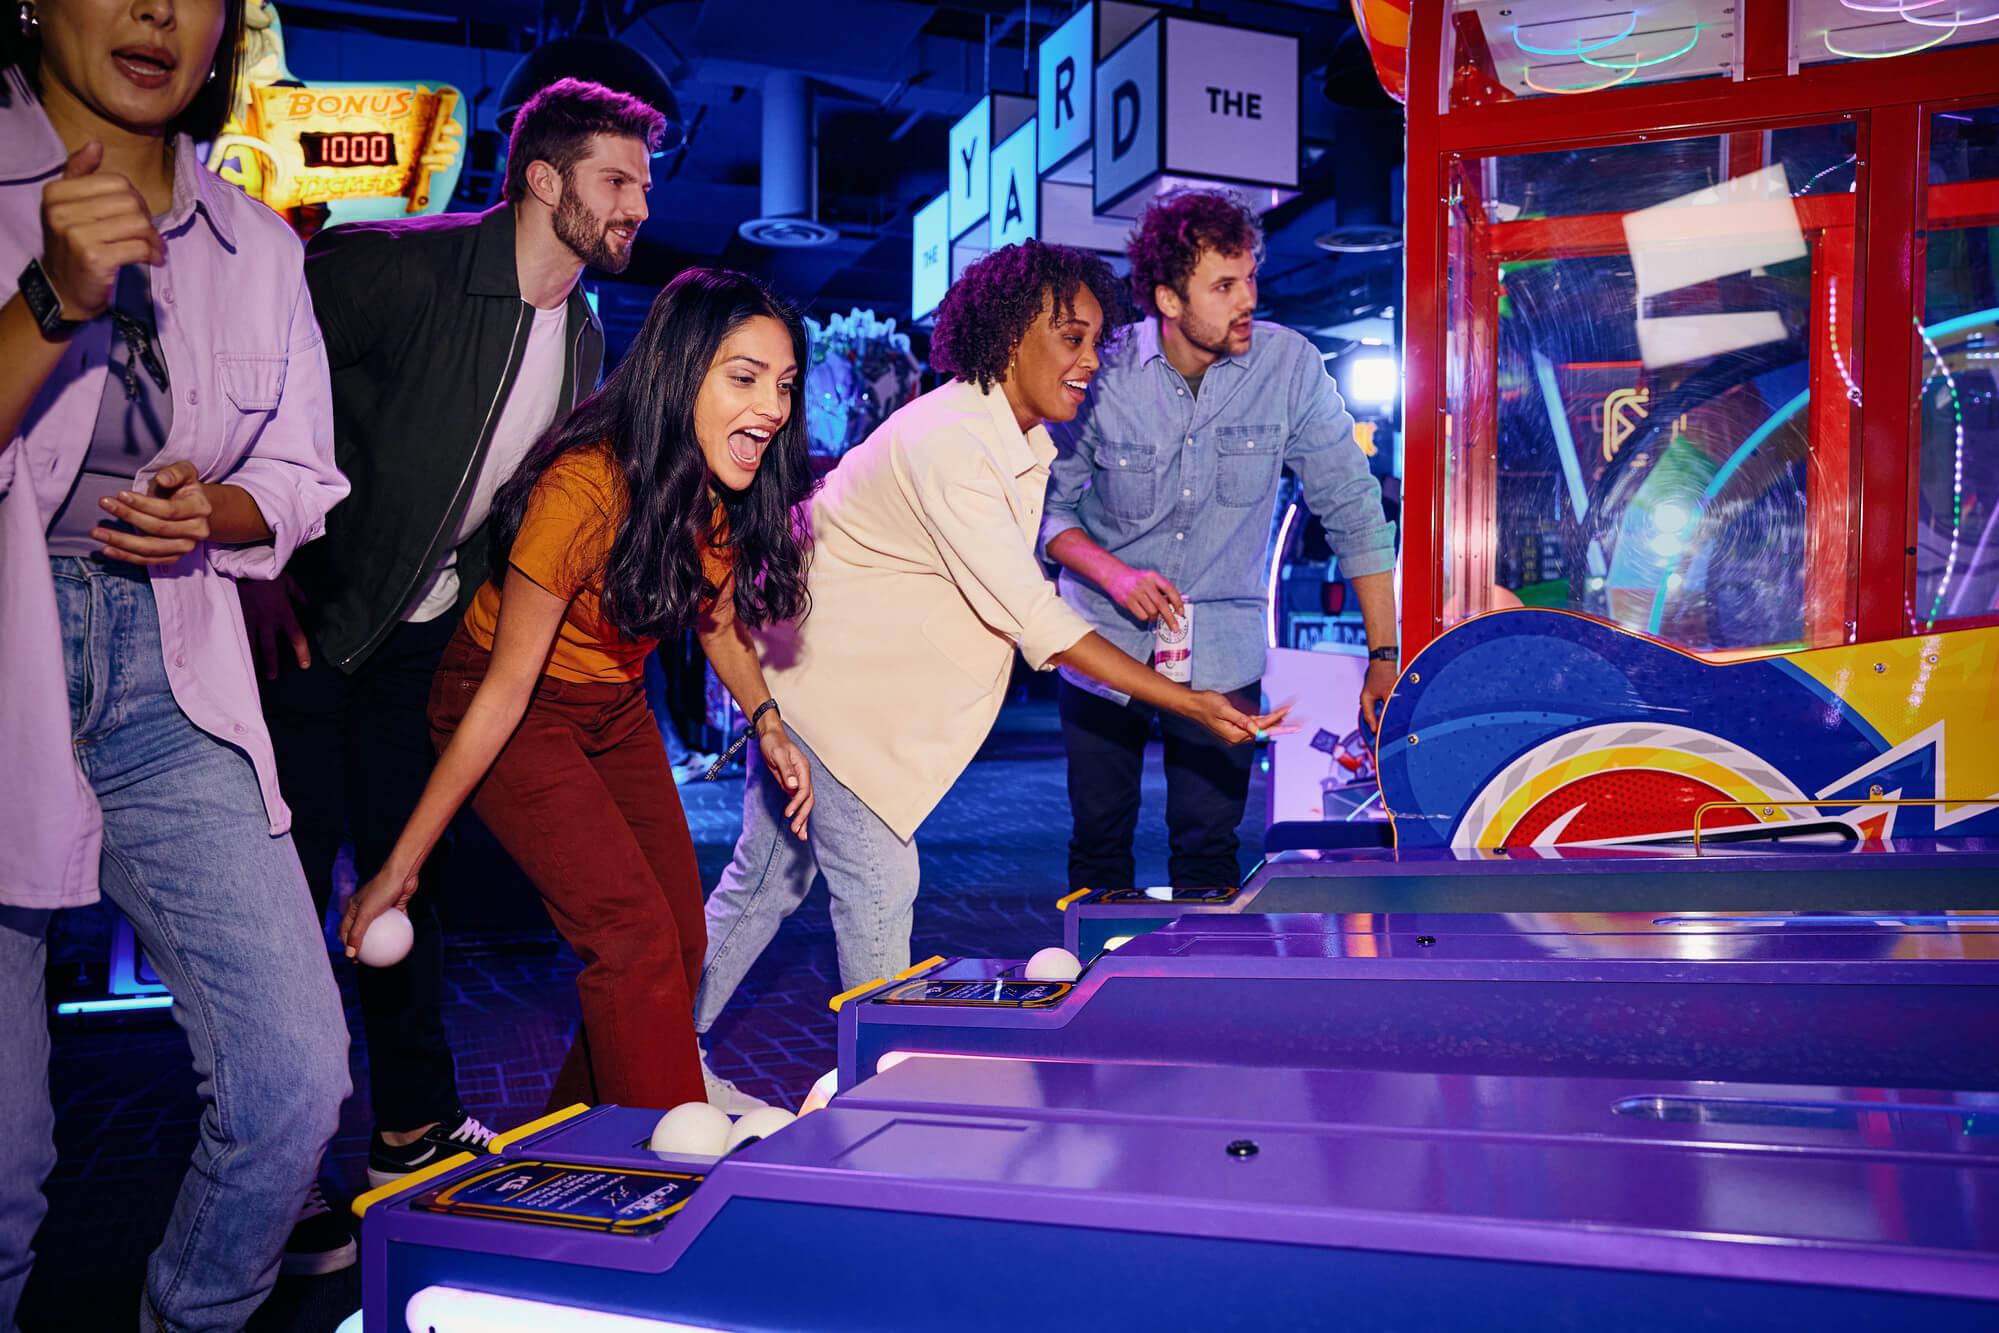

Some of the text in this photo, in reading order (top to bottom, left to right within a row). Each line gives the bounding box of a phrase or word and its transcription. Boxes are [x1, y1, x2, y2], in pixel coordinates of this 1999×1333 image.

[287, 91, 414, 118] BONUS
[1205, 86, 1262, 120] THE
[321, 135, 388, 163] 1000
